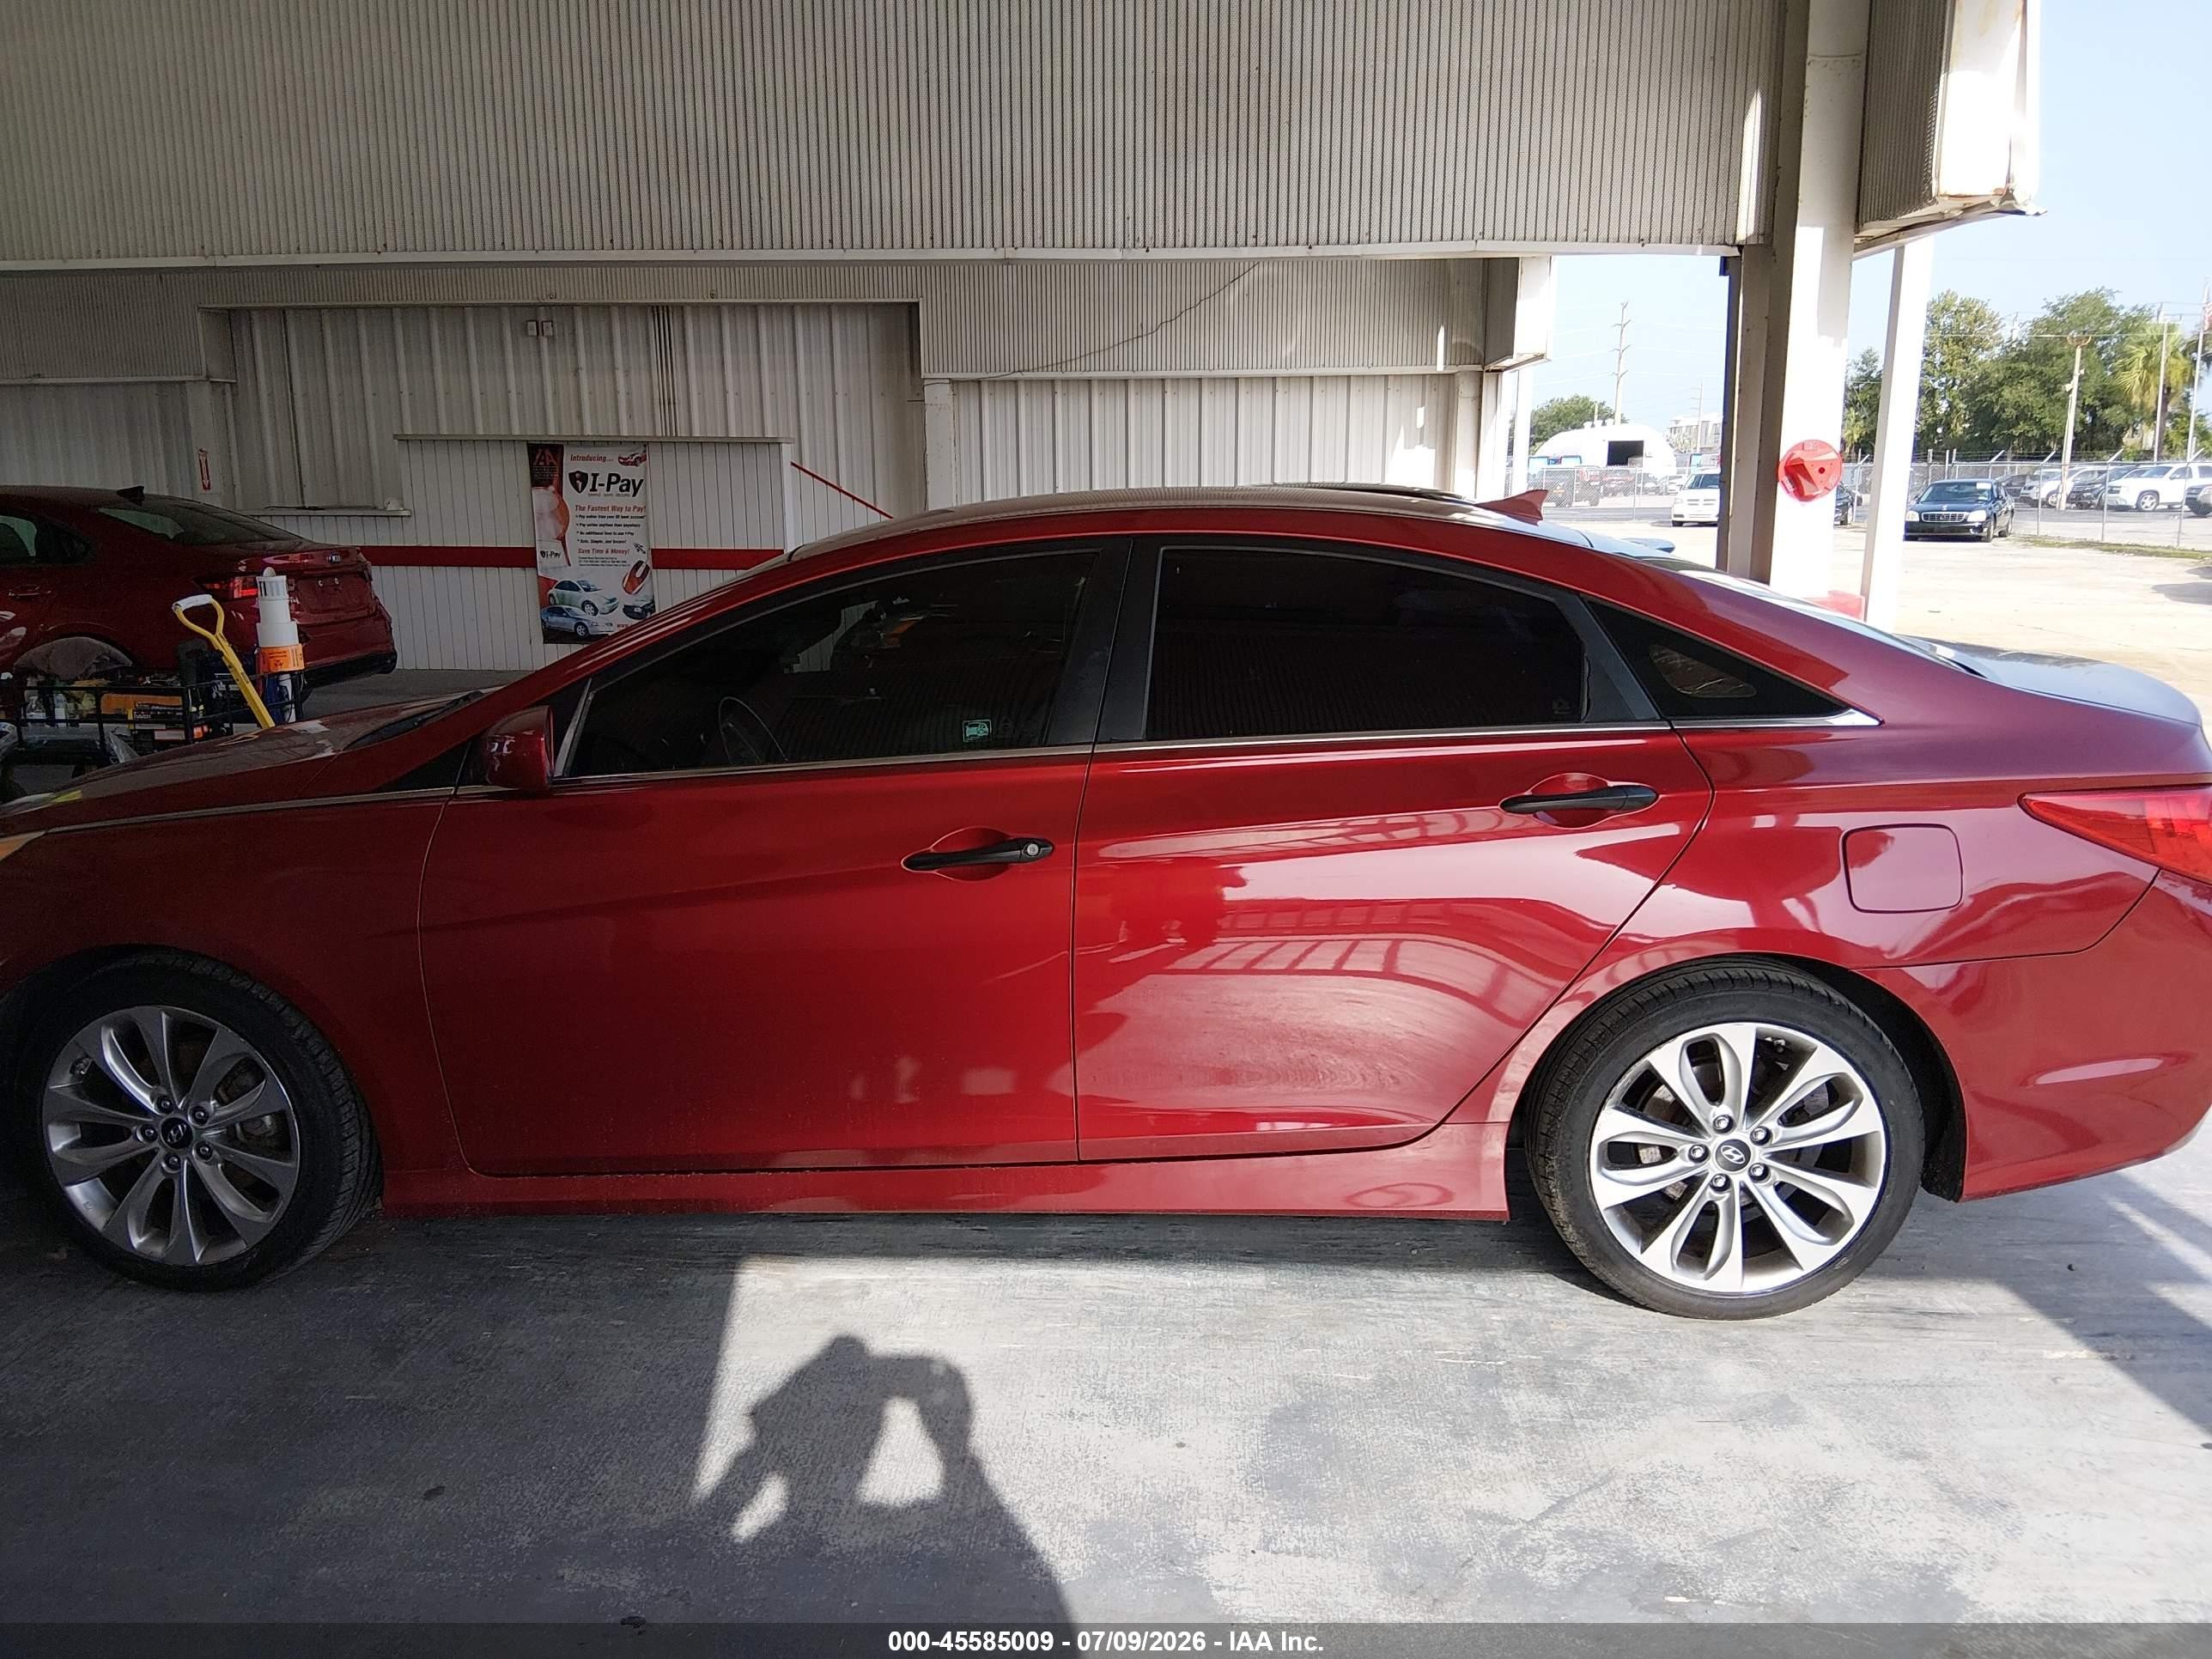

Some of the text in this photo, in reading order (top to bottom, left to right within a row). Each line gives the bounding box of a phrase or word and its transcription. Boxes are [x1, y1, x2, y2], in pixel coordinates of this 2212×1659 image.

[589, 472, 645, 497] I-Pay
[611, 505, 624, 514] Way
[633, 505, 647, 514] Pay!
